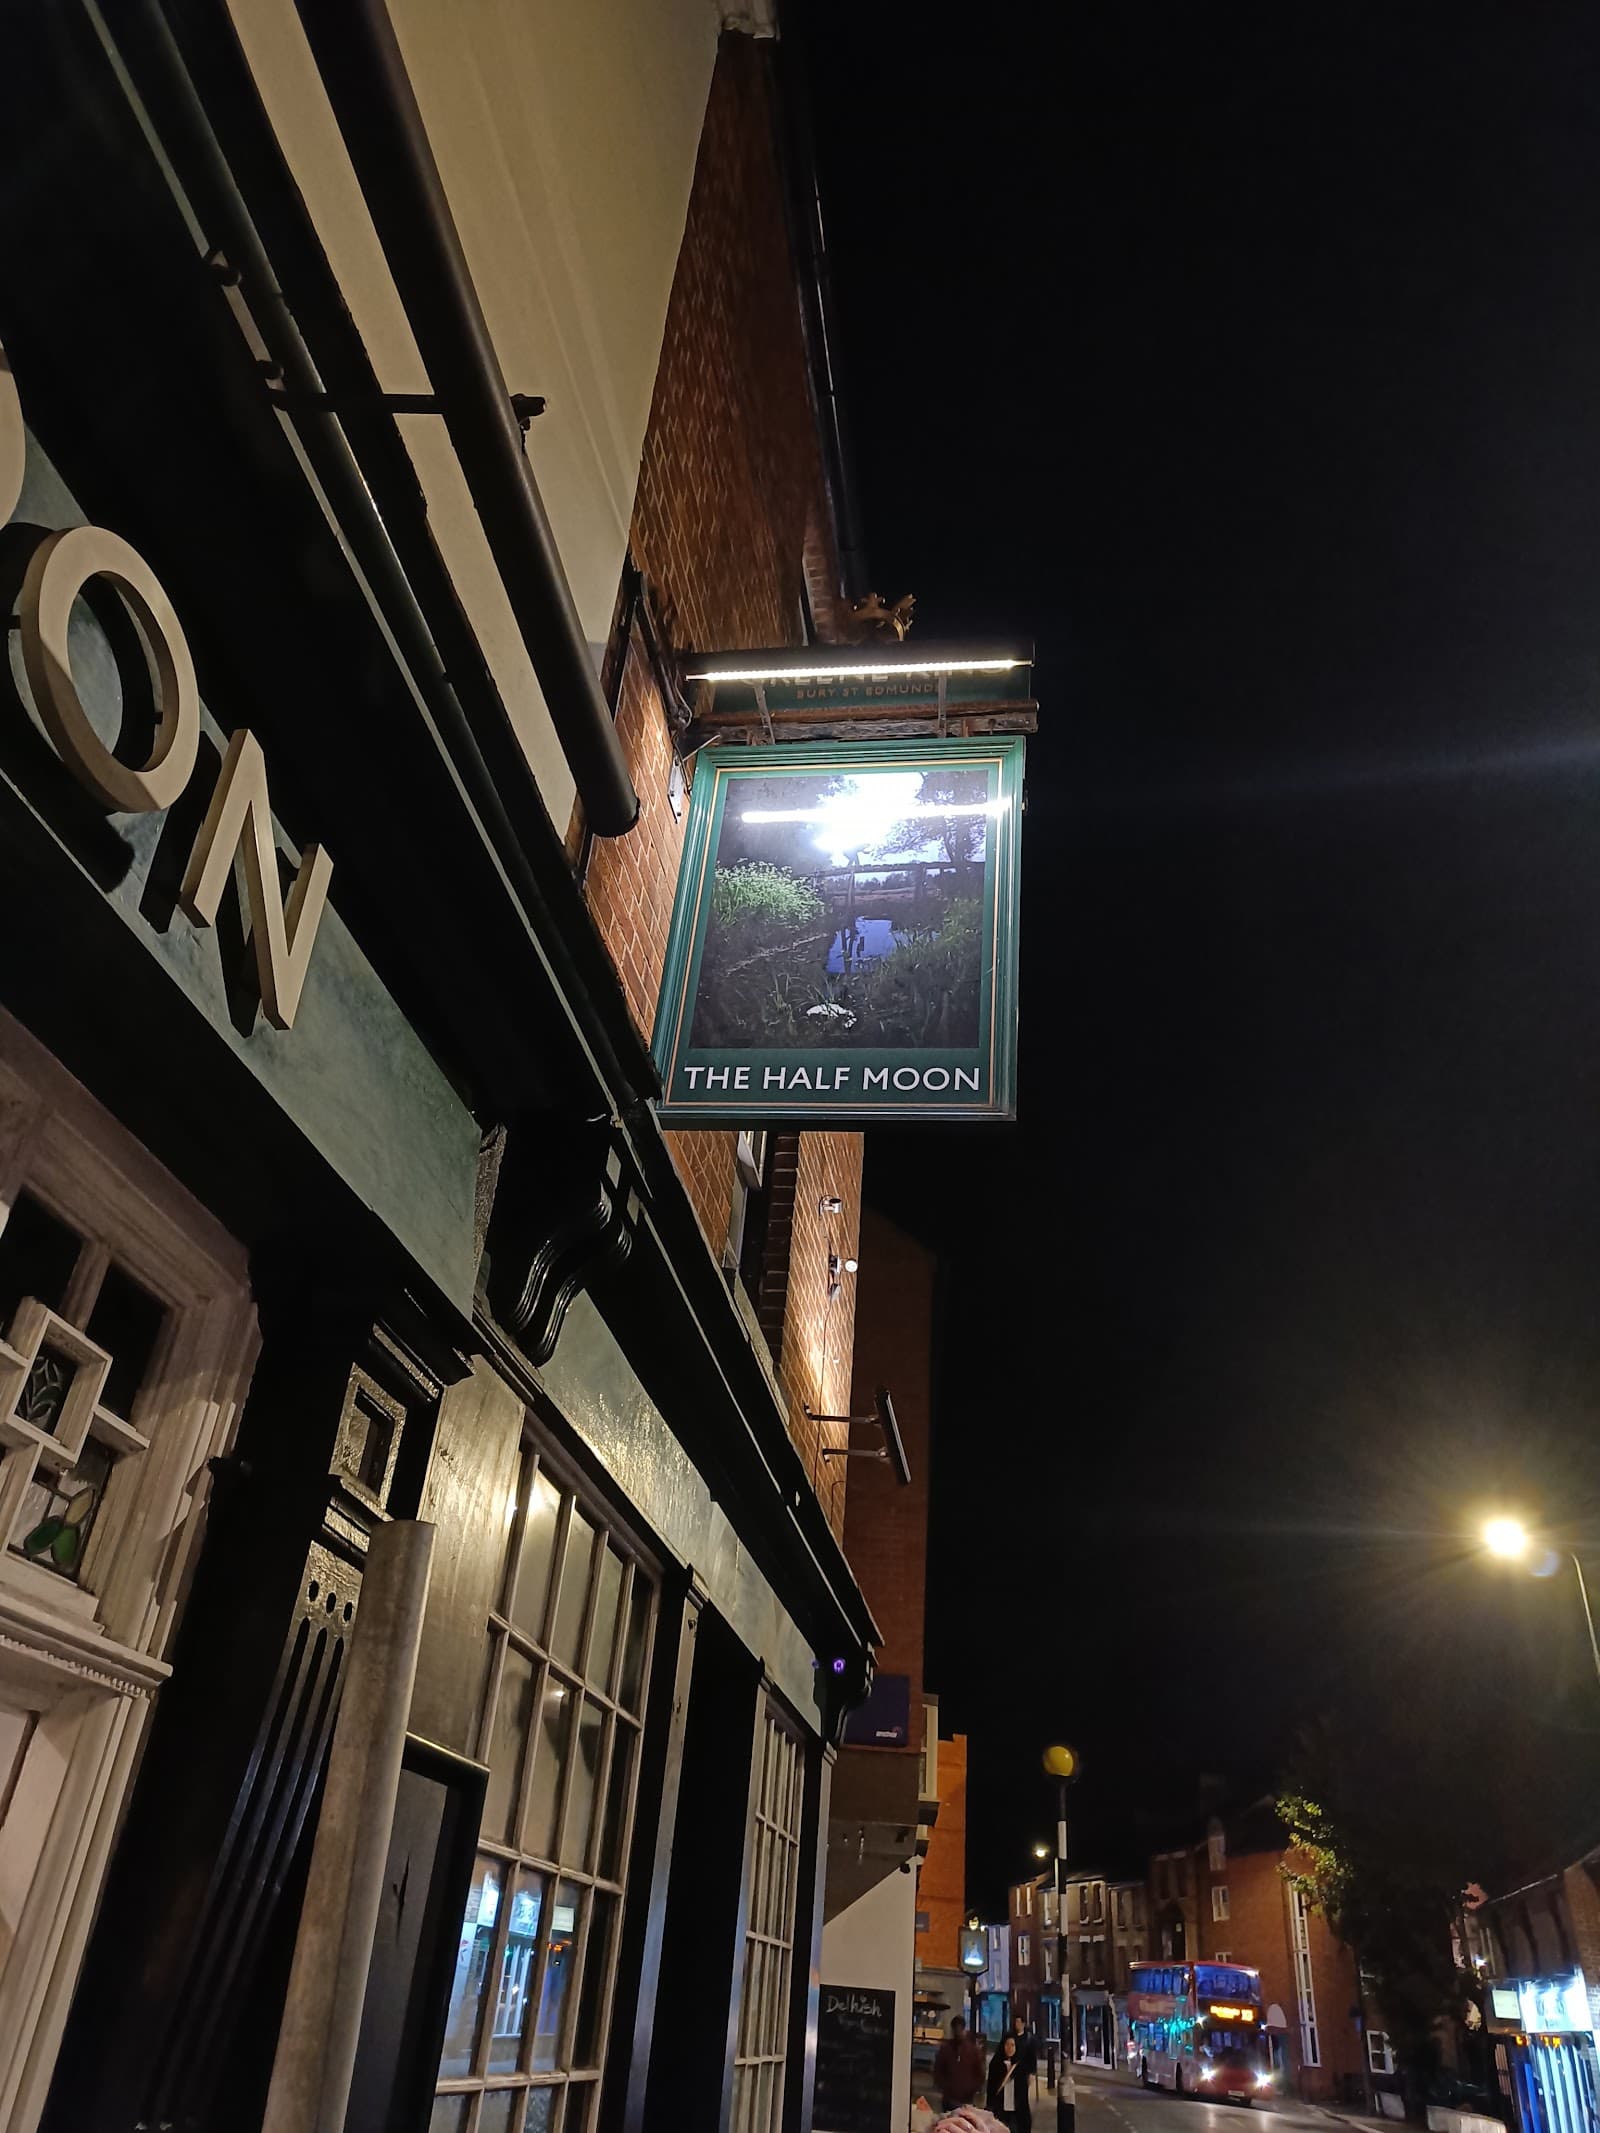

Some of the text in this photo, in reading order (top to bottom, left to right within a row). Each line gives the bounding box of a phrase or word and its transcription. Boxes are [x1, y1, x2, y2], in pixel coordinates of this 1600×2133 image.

[0, 338, 334, 1031] ON
[796, 687, 836, 699] BURY
[842, 687, 859, 698] ST
[684, 1066, 980, 1091] THE HALF MOON
